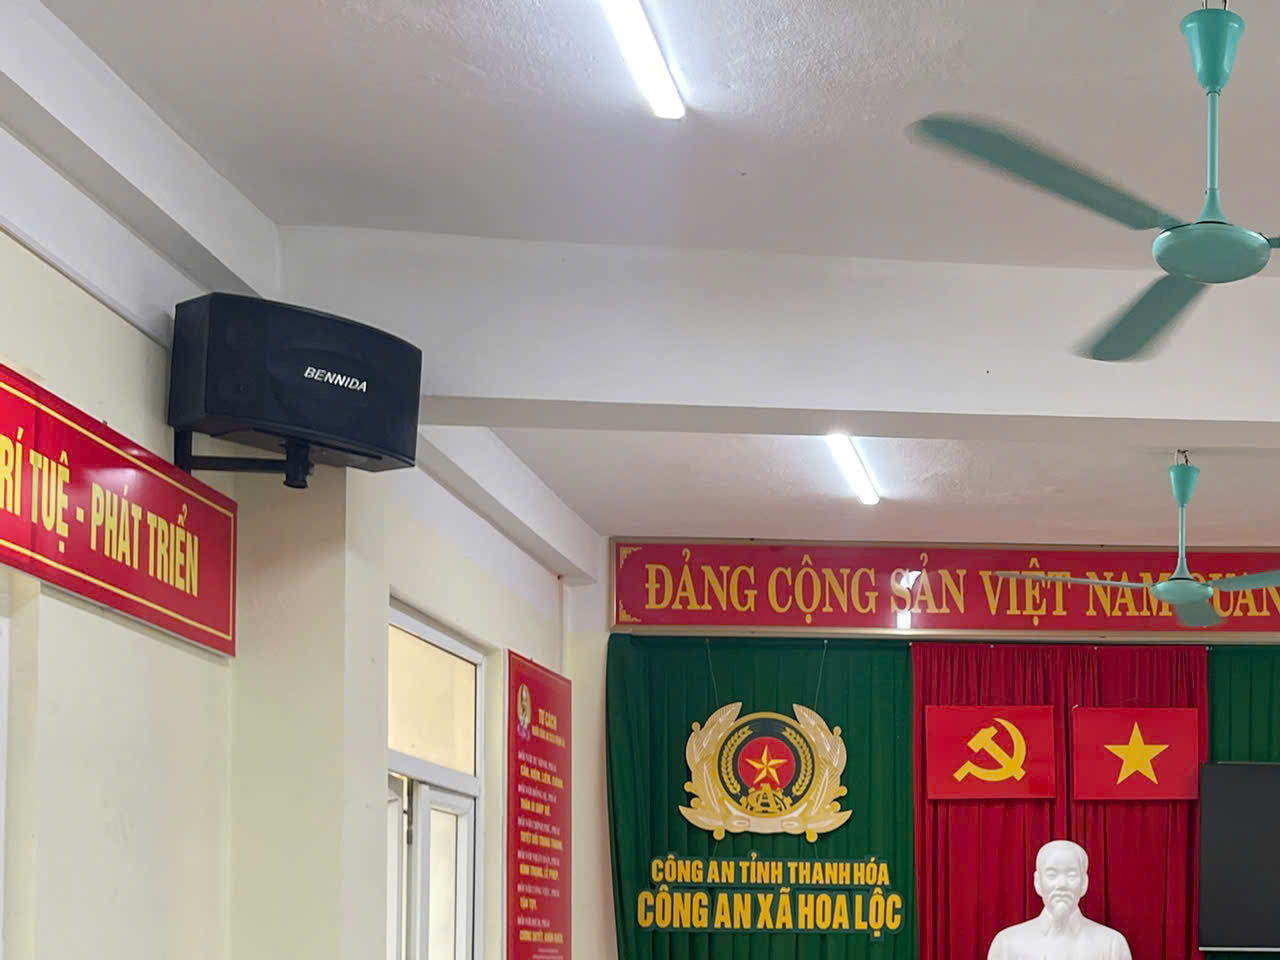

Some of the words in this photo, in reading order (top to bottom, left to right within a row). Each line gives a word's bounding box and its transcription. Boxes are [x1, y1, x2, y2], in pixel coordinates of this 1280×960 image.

[304, 366, 367, 393] BENNIDA
[29, 448, 71, 555] TUỆ
[90, 482, 142, 571] PHÁT
[147, 503, 200, 598] TRIỂN
[644, 549, 758, 612] ĐẢNG
[768, 553, 878, 625] CỘNG
[889, 552, 966, 615] SẢN
[978, 557, 1072, 627] VIỆT
[1086, 571, 1173, 617] NAM
[651, 854, 704, 884] CÔNG
[707, 860, 735, 884] AN
[739, 852, 783, 885] TỈNH
[787, 861, 851, 886] THANH
[853, 856, 890, 886] HÓA
[637, 884, 709, 930] CÔNG
[713, 893, 752, 930] AN
[757, 887, 794, 930] XÃ
[797, 893, 850, 930] HOA
[854, 887, 902, 937] LỘC
